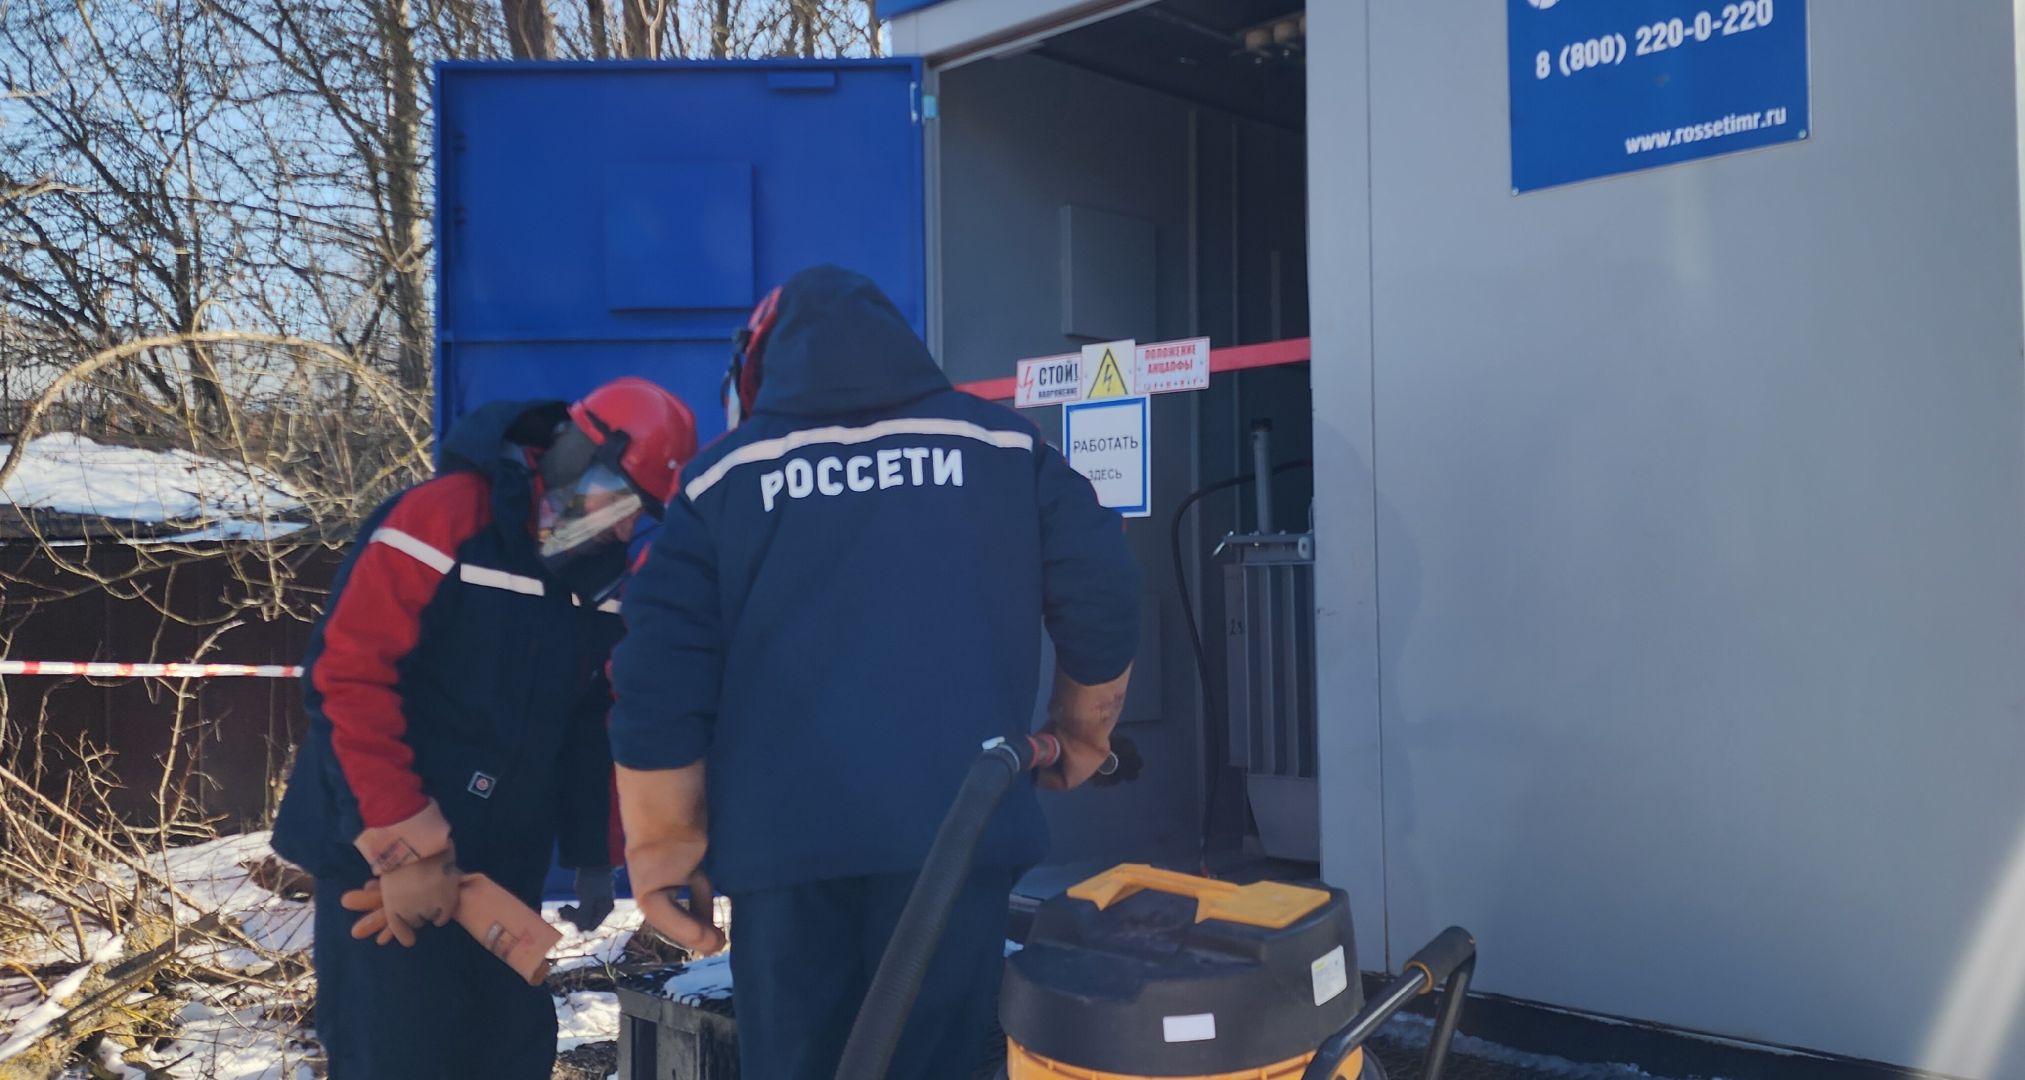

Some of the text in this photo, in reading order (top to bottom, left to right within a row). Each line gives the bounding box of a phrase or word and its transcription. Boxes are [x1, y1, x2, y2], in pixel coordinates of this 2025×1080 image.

[1536, 0, 1774, 80] 8 (800) 220-0-220
[1625, 106, 1787, 154] www.rossetimr.ru
[1039, 361, 1078, 385] СТОЙ!
[1073, 436, 1139, 453] РАБОТАТЬ
[760, 447, 964, 512] РОССЕТИ
[1088, 469, 1123, 481] ЗДЕСЬ
